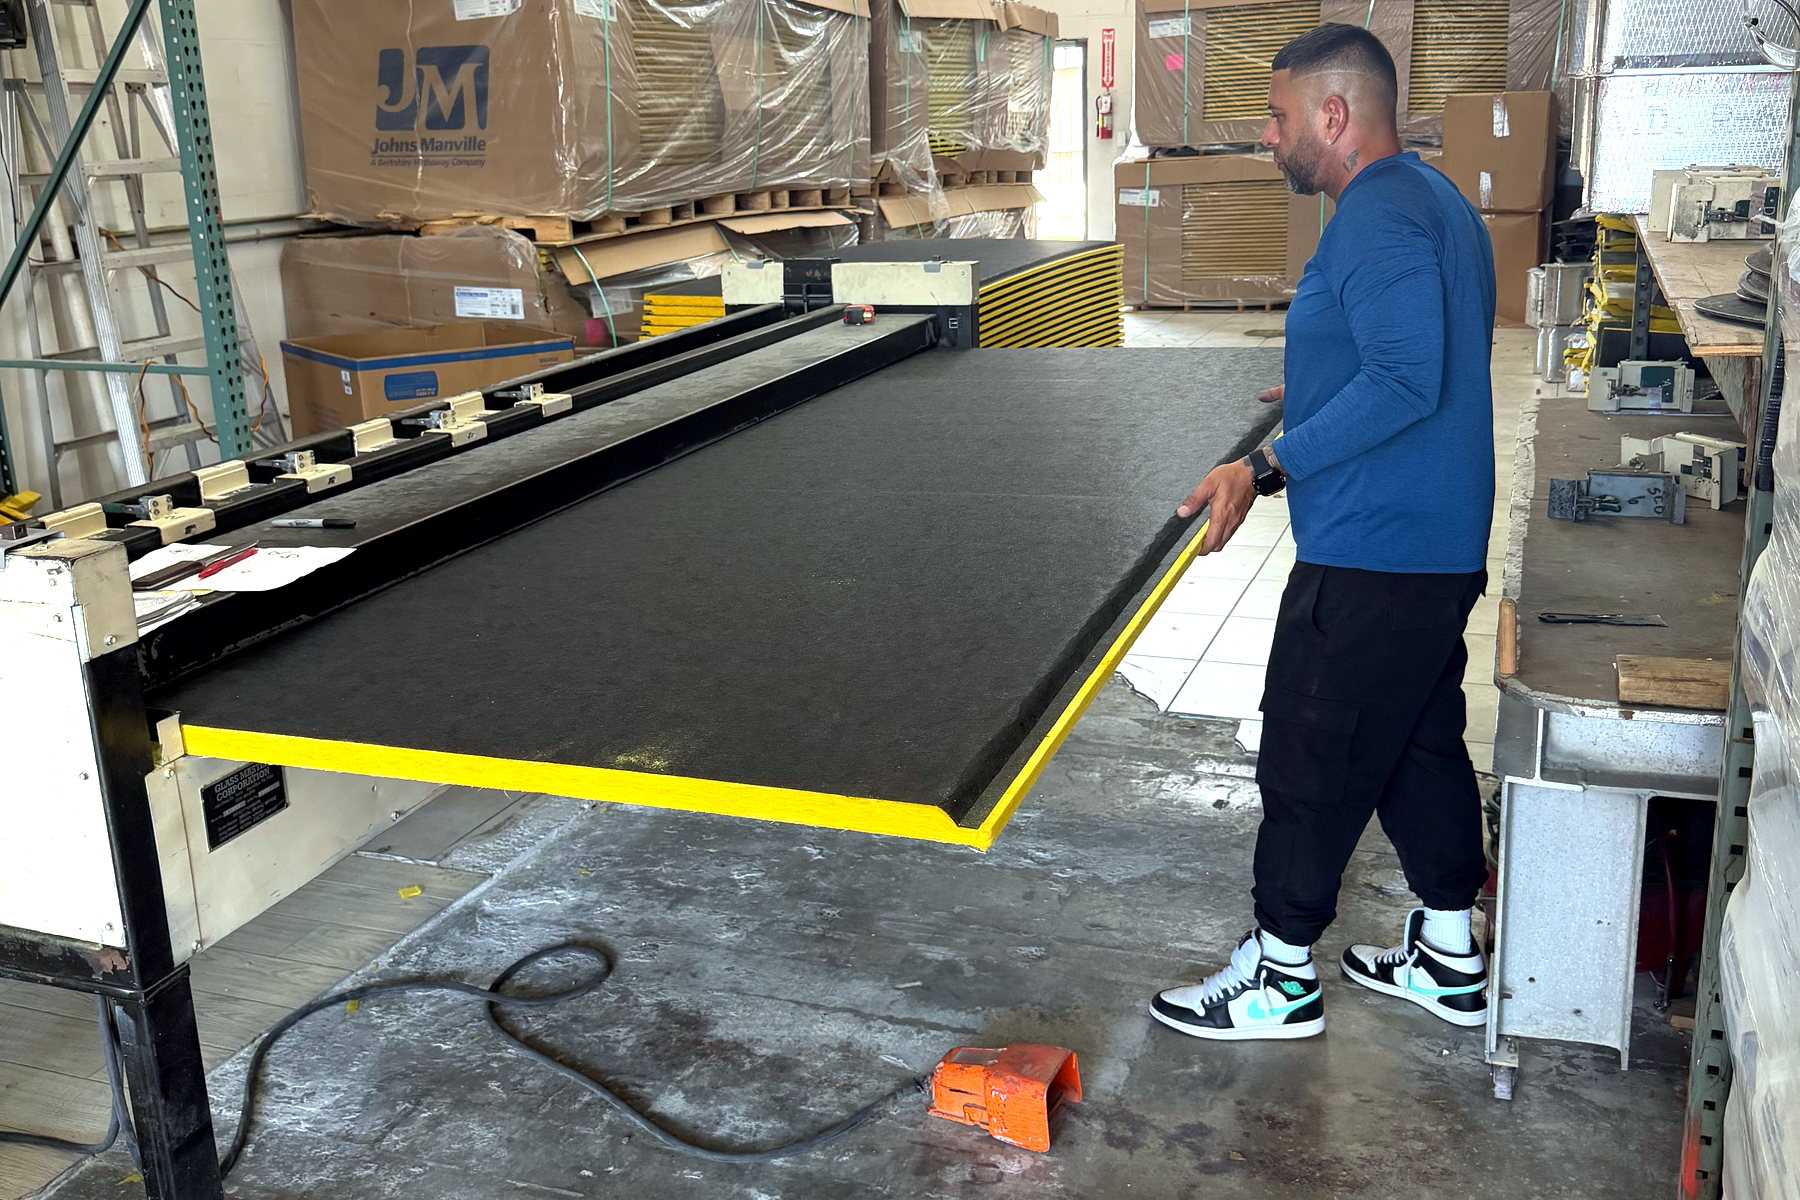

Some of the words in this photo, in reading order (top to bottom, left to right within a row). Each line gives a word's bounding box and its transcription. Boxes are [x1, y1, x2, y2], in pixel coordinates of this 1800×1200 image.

[376, 45, 489, 130] JM
[371, 138, 417, 154] Johns
[420, 136, 486, 152] Manville
[414, 158, 450, 168] Hthaway
[452, 158, 486, 168] Company
[214, 774, 239, 793] GLASS
[216, 767, 270, 801] CORPORATION
